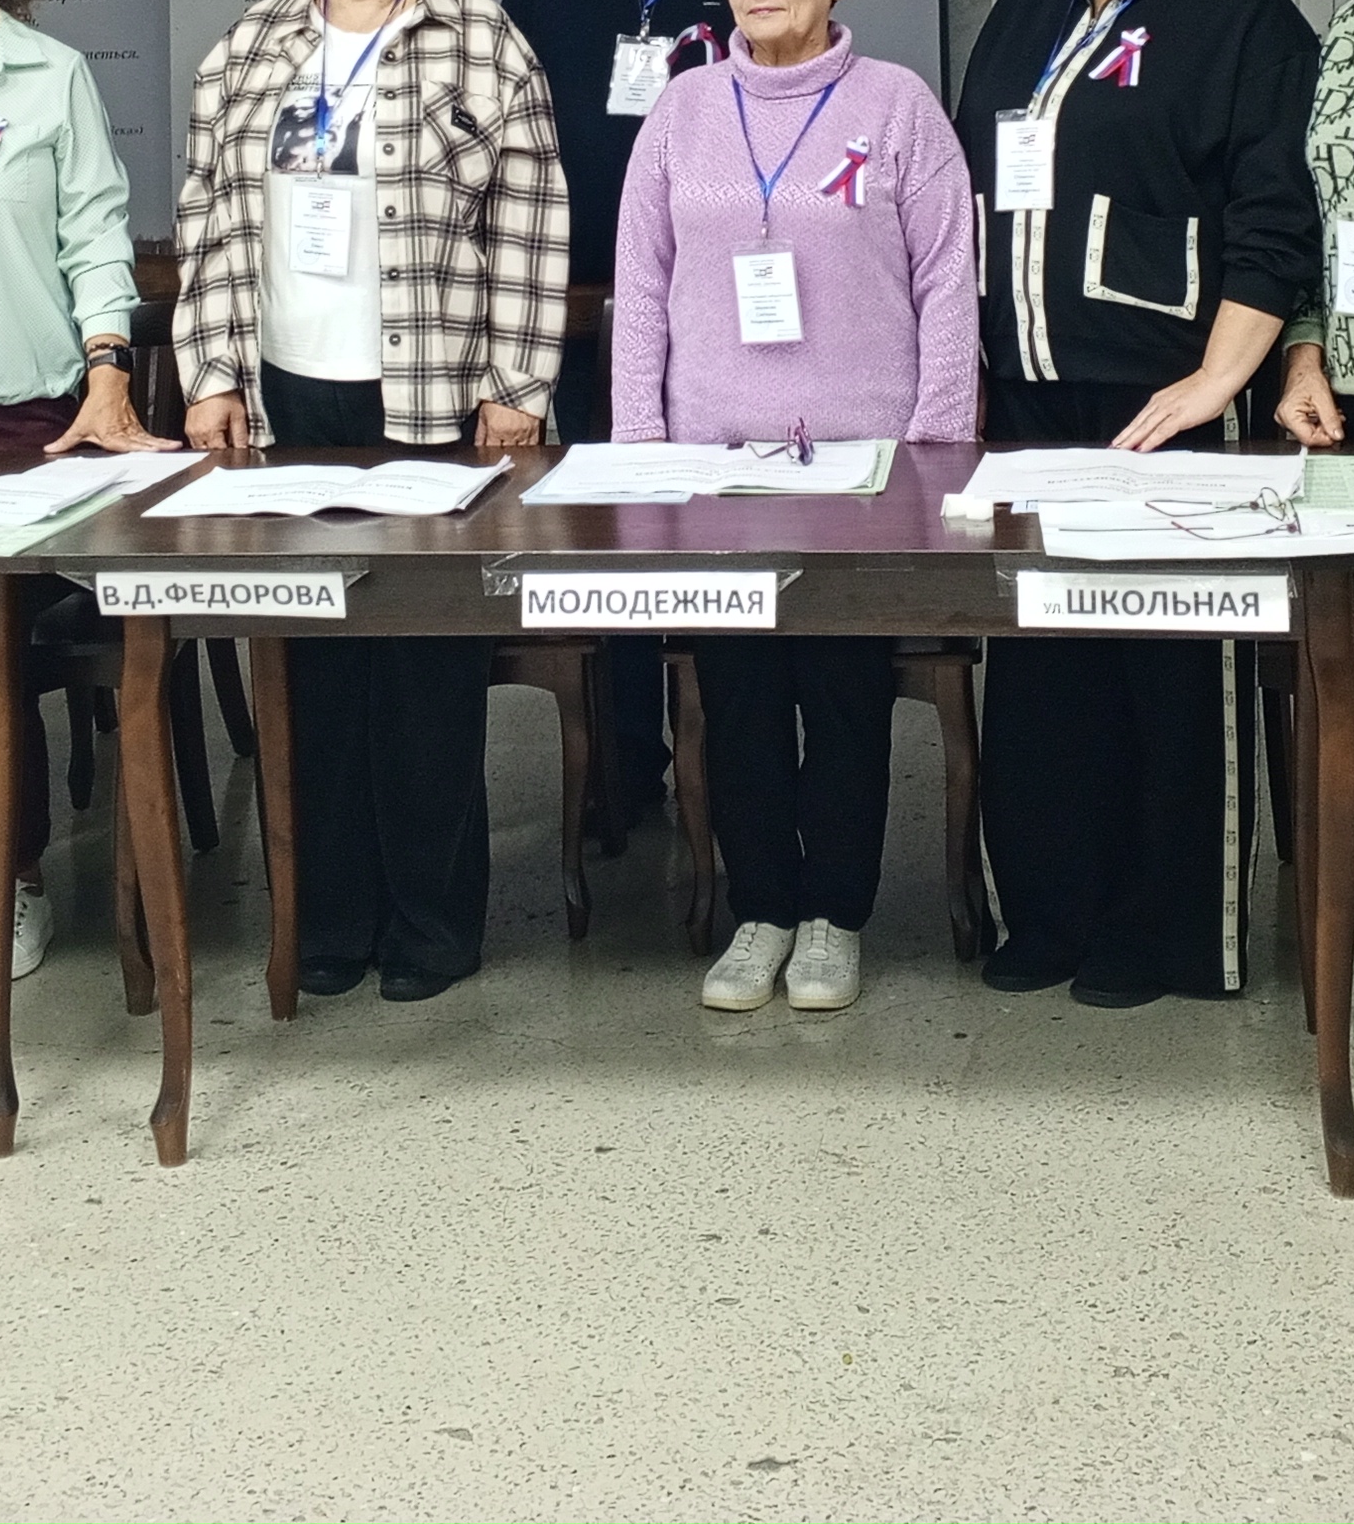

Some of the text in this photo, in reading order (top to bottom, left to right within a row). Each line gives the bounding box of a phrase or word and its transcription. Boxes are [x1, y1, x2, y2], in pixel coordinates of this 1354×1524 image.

[102, 583, 336, 610] В.Д.ФЕДОРОВА
[527, 589, 764, 620] МОЛОДЕЖНАЯ
[1066, 588, 1261, 618] ШКОЛЬНАЯ
